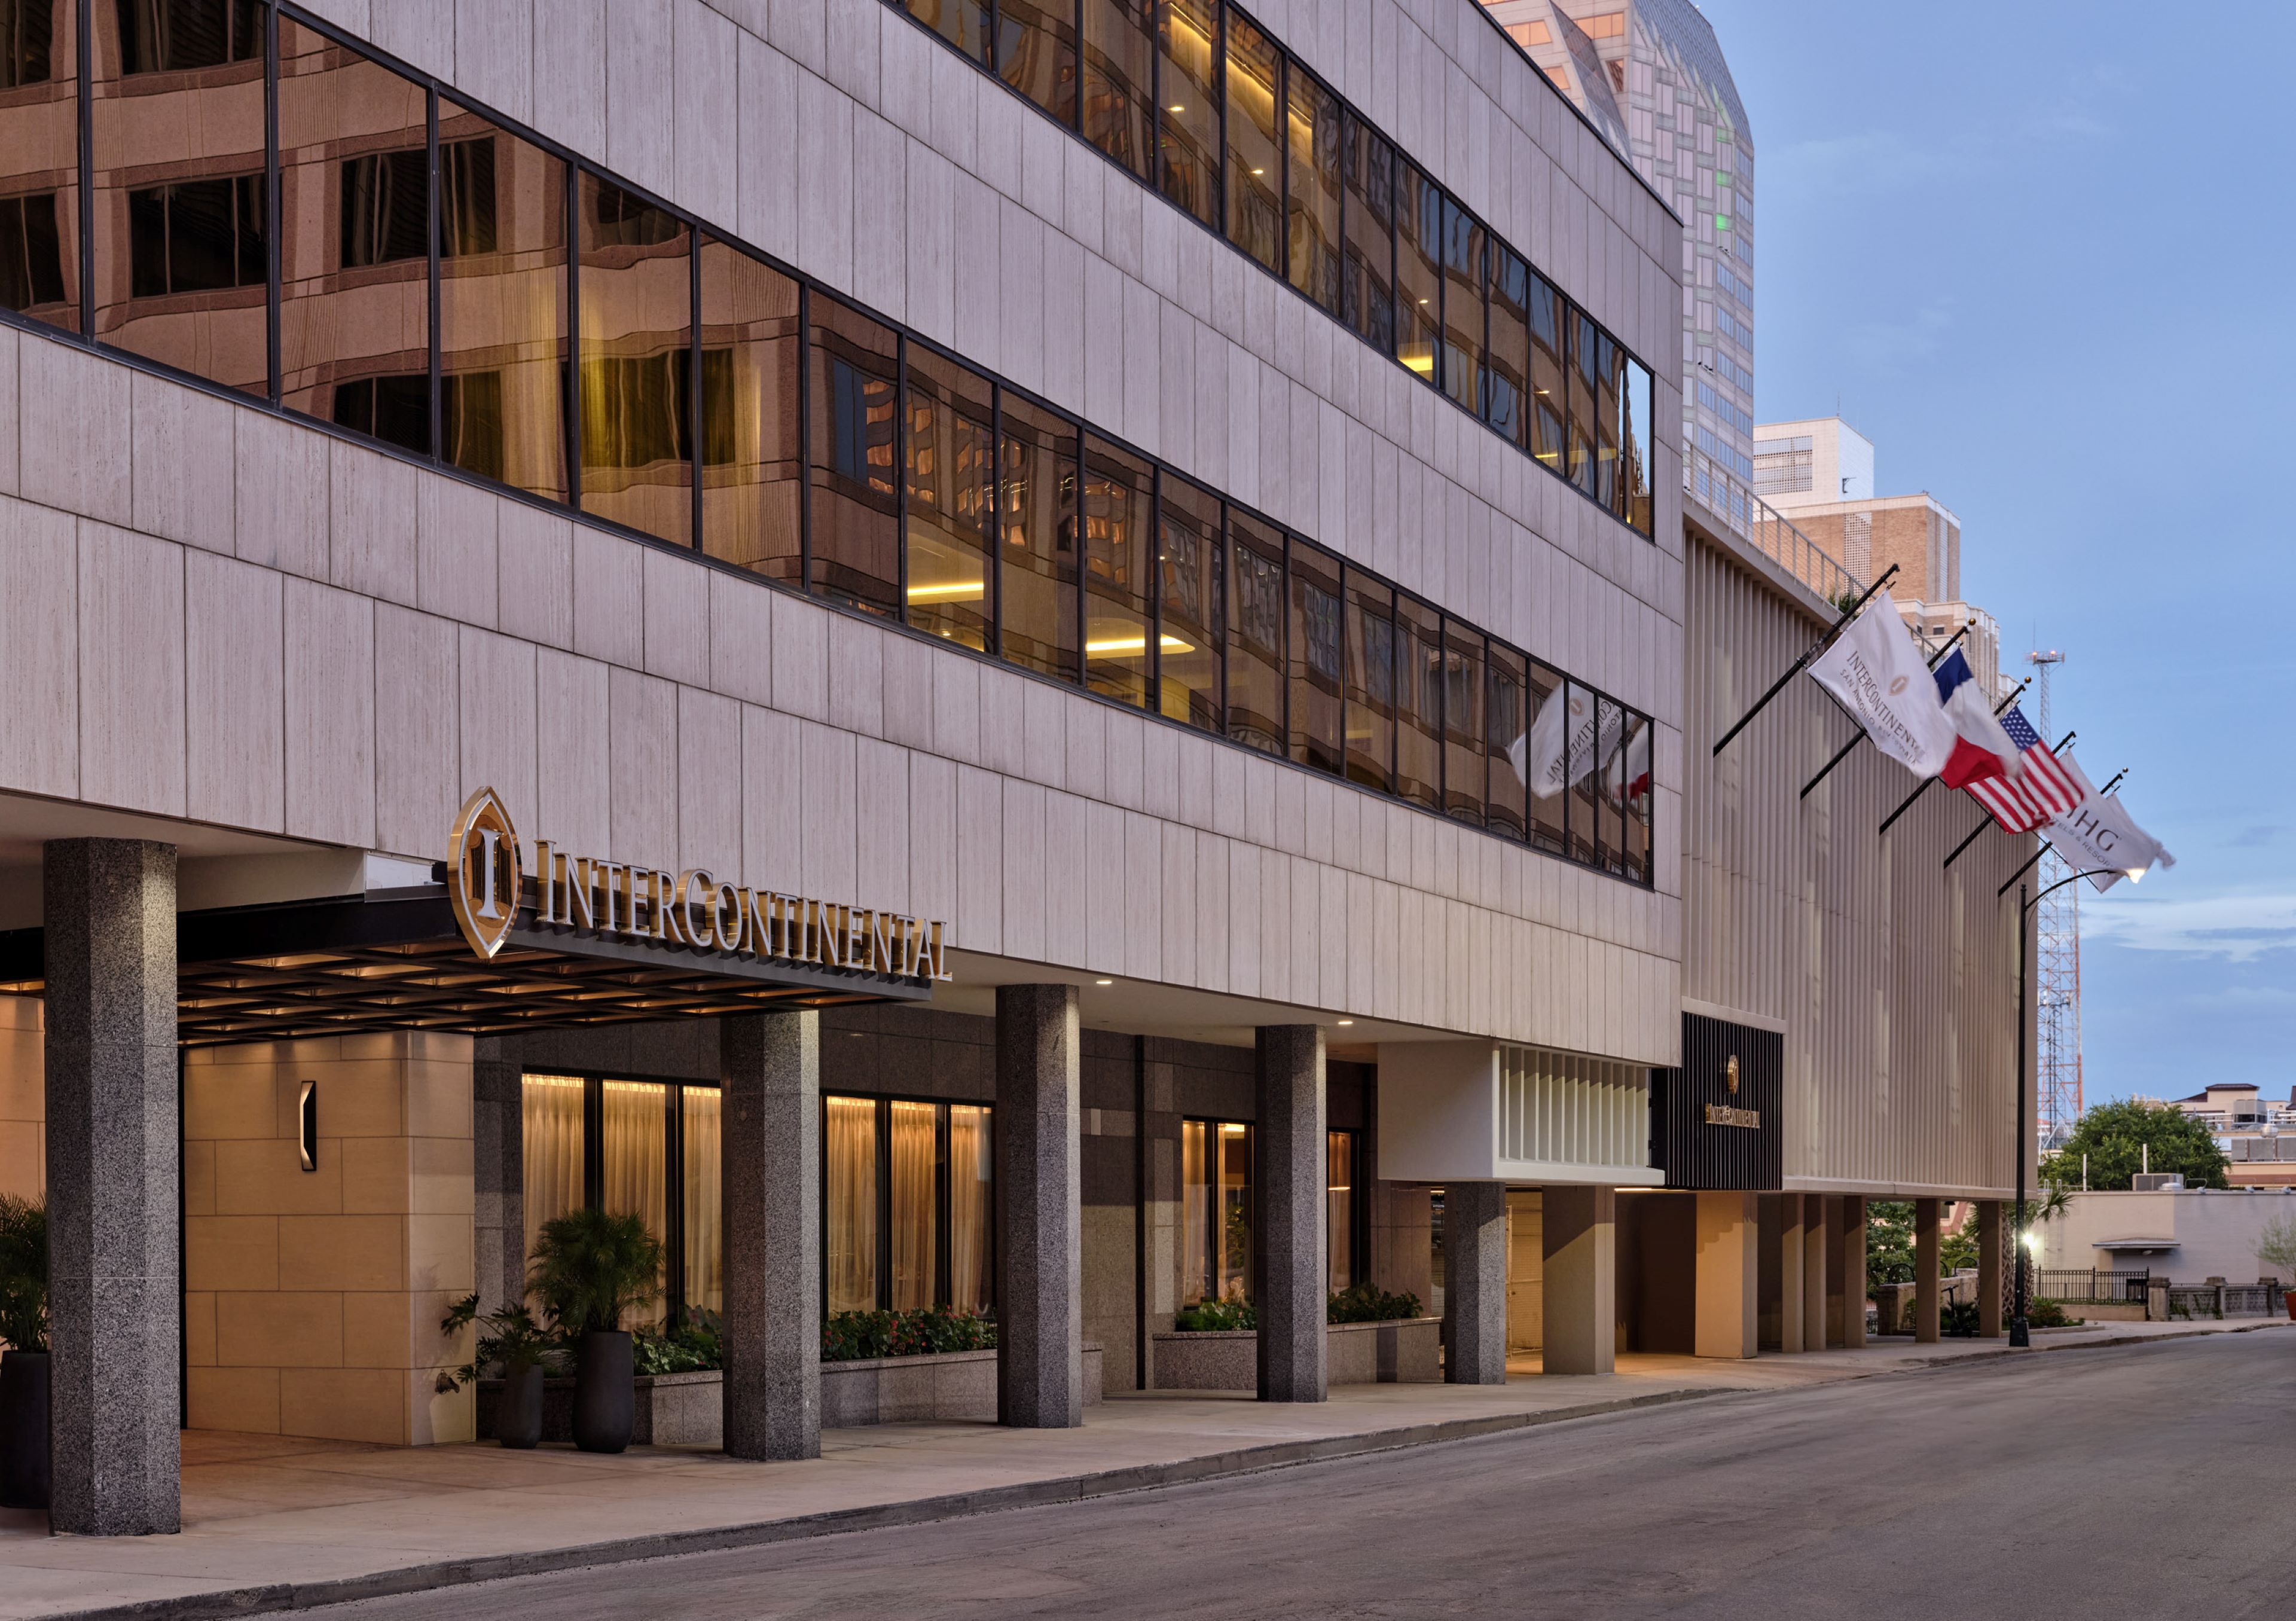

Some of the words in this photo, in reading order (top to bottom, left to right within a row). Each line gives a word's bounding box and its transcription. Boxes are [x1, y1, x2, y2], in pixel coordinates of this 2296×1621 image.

[1840, 669, 1855, 687] SAN
[1852, 689, 1875, 725] ANTONIO
[2051, 816, 2074, 835] TELS
[2082, 841, 2114, 867] RESOR
[534, 839, 952, 981] INTERCONTINENTAL
